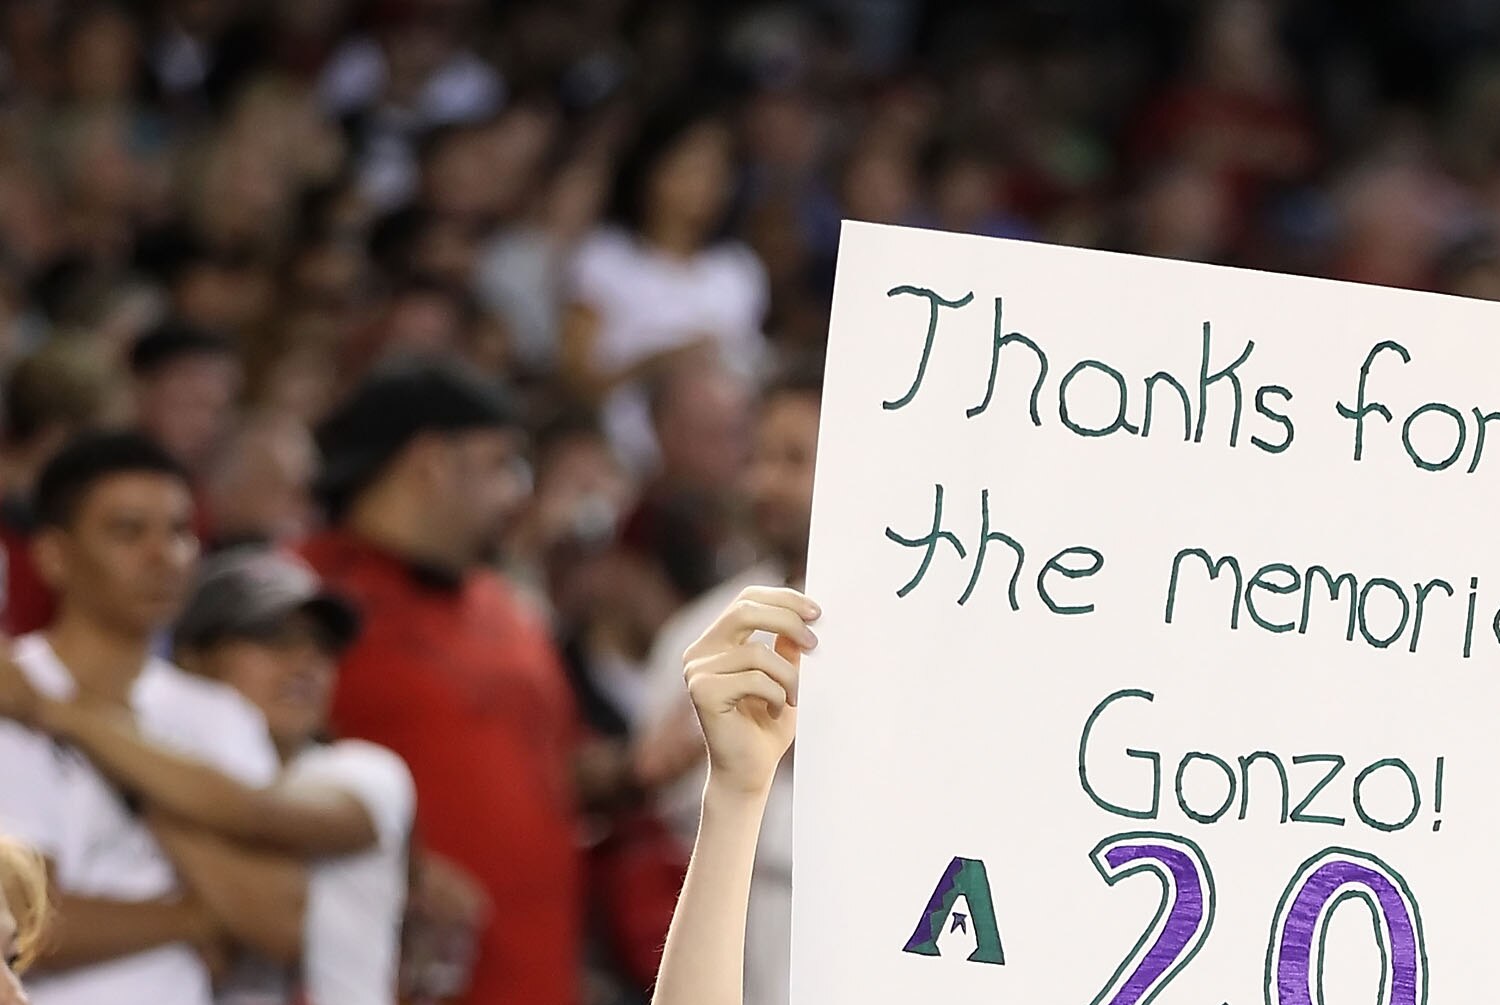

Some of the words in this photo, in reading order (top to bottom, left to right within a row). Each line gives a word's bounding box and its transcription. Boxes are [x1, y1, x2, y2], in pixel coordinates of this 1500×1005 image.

[883, 284, 1294, 454] Thanks
[885, 484, 1104, 615] the
[1079, 689, 1445, 832] Gonzo!
